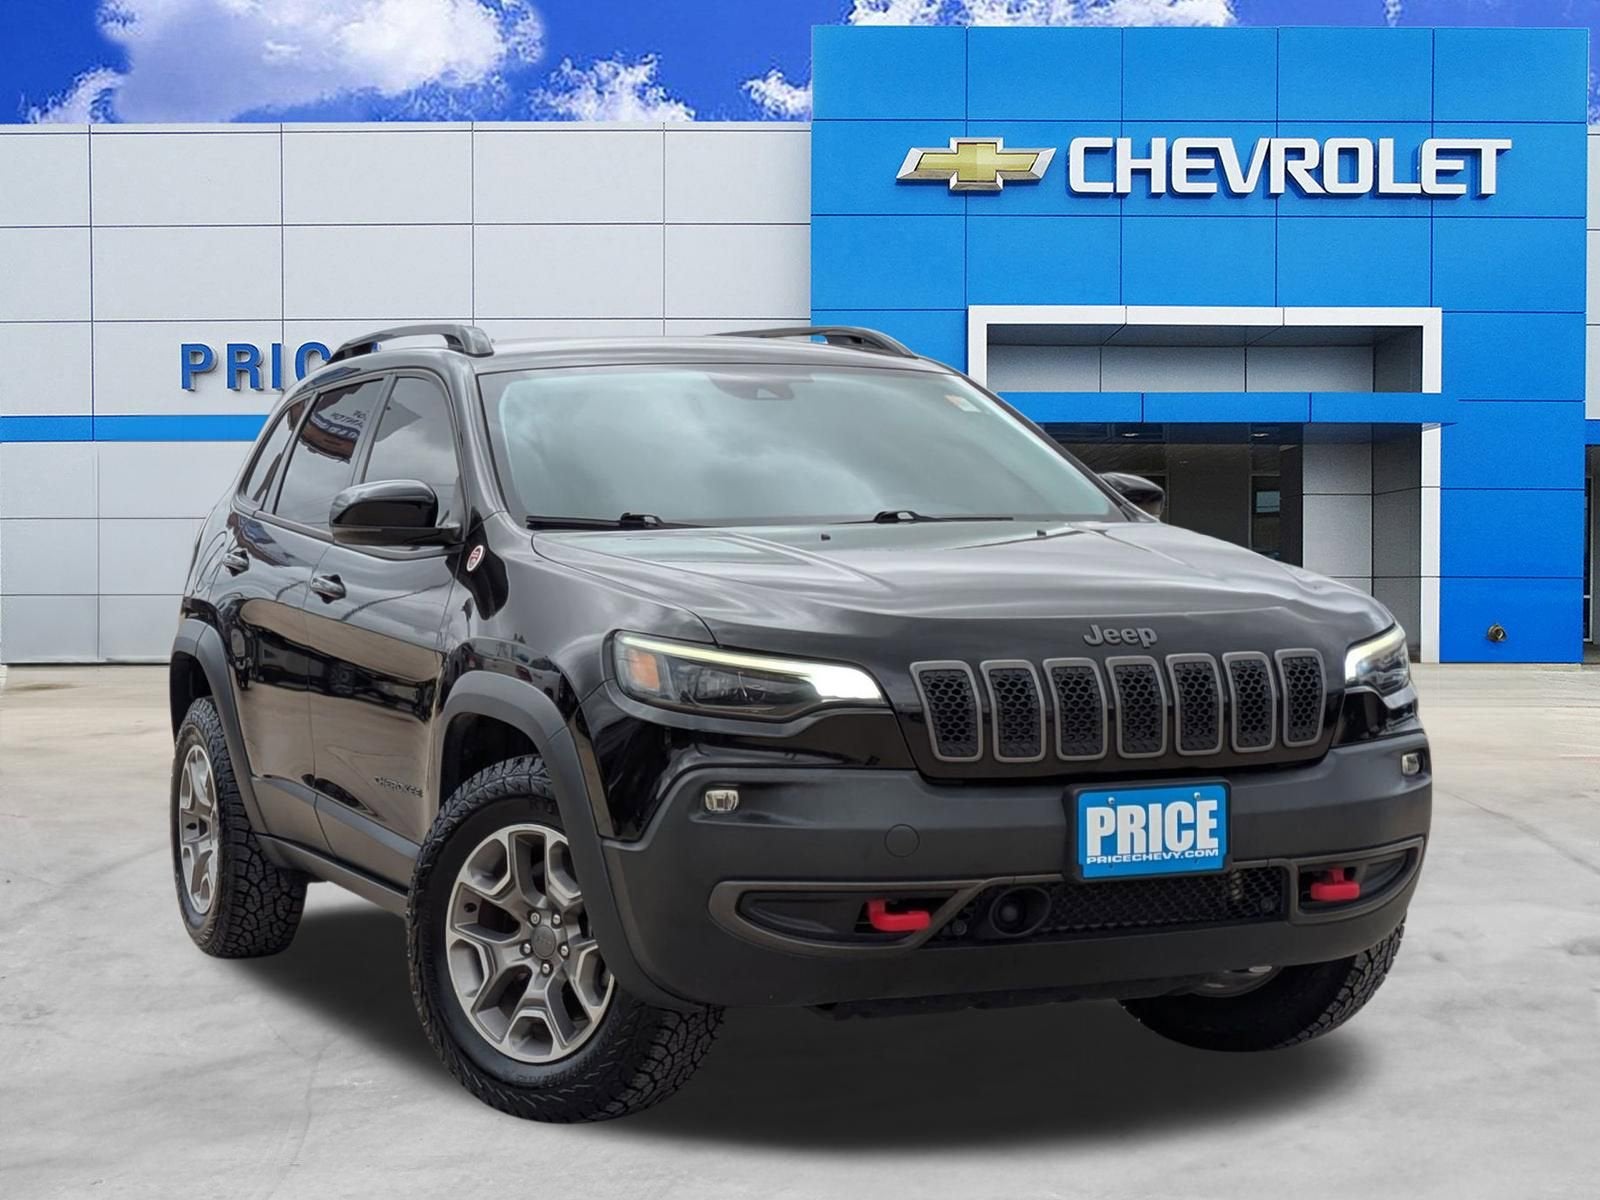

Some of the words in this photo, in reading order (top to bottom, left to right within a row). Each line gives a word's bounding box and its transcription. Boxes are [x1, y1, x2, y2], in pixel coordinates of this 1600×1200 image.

[1068, 136, 1512, 196] CHEVROLET
[181, 341, 379, 392] PRIC
[1082, 623, 1158, 649] Jeep
[1086, 800, 1219, 857] PRICE
[1086, 849, 1219, 865] PRICECHEVY.COM
